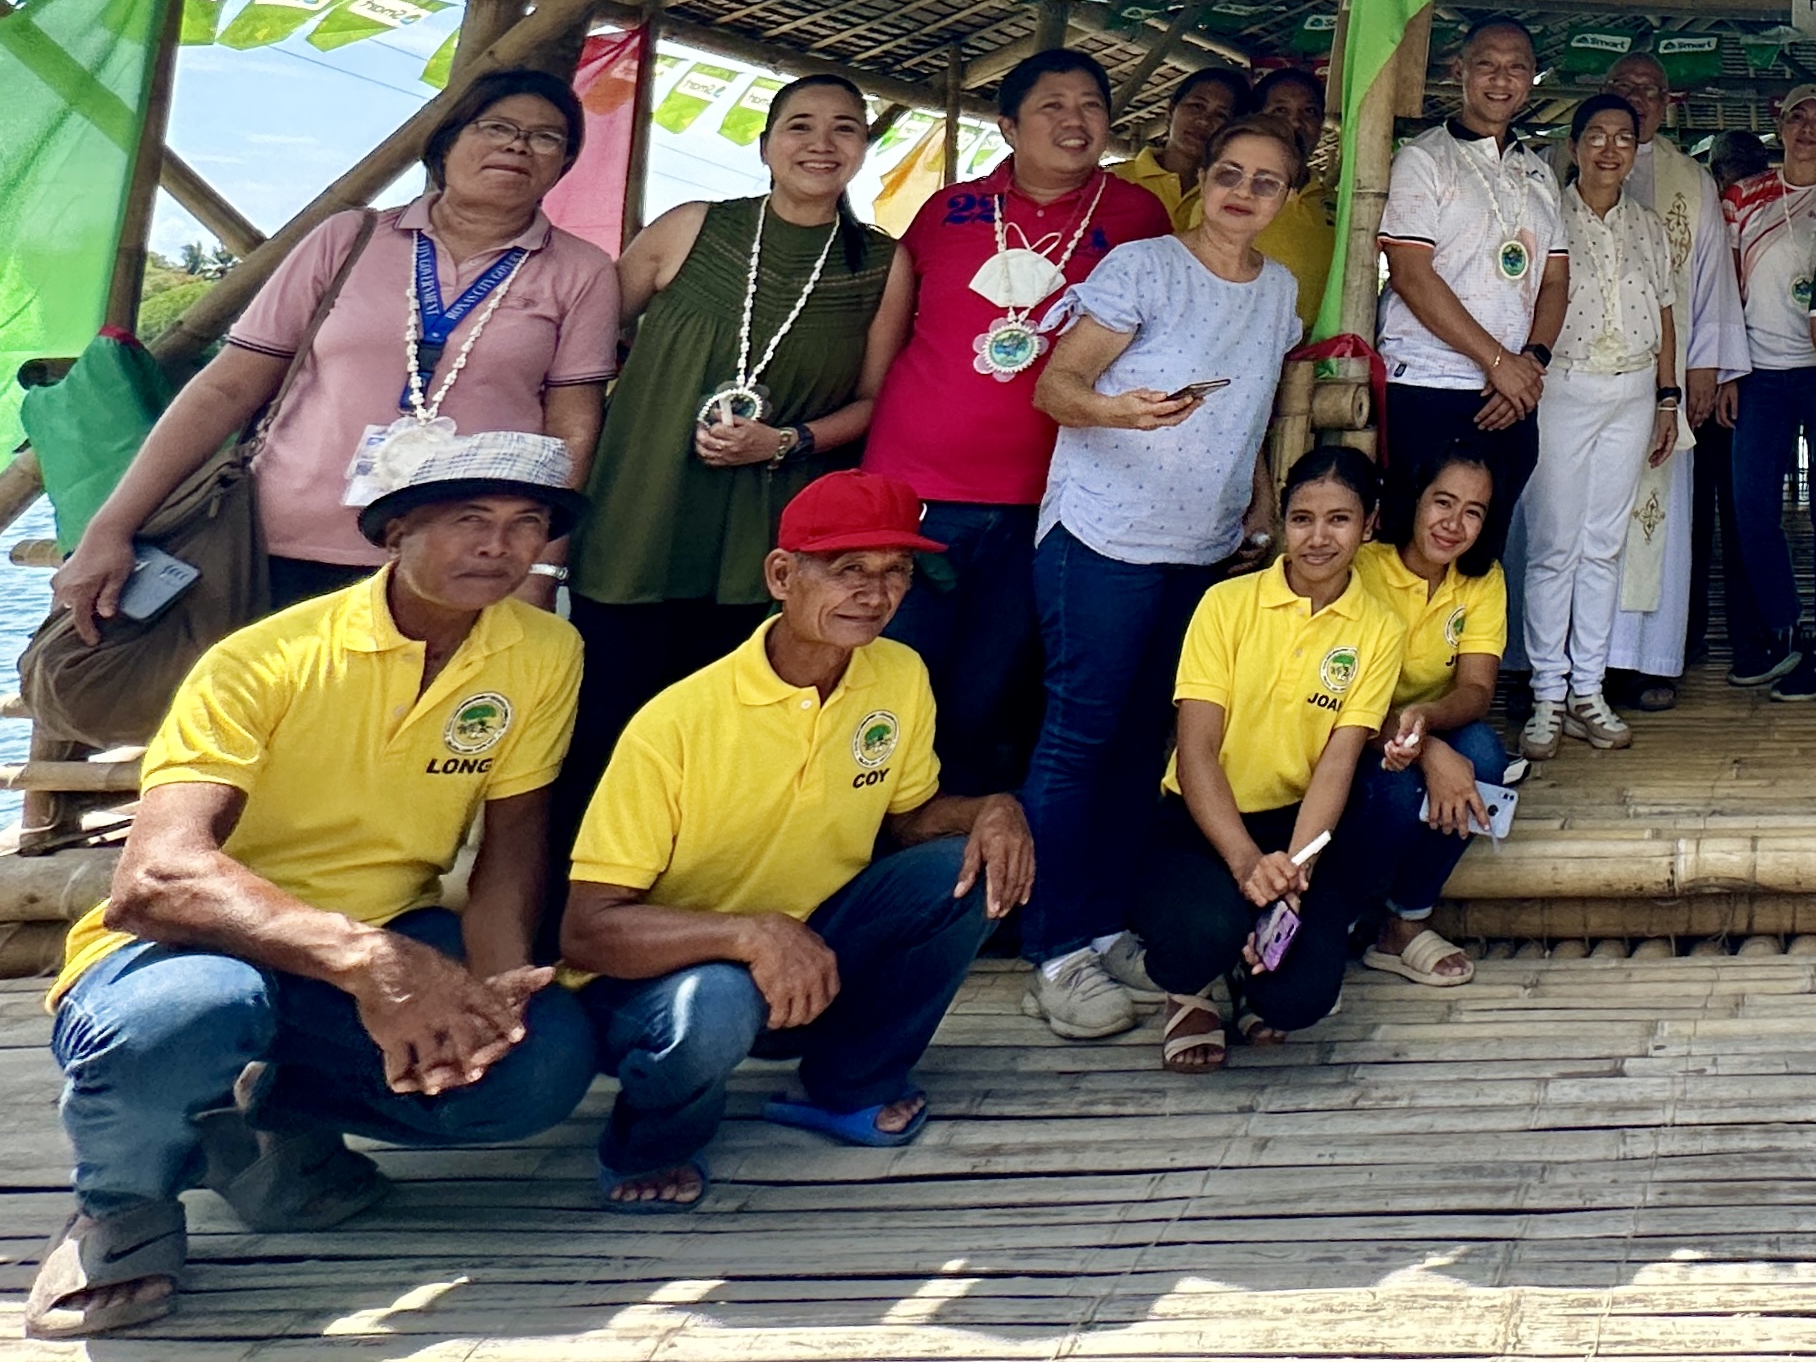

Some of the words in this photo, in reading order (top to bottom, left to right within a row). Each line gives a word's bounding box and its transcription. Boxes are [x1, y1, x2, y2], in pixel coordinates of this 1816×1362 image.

[942, 193, 1005, 227] 22
[419, 259, 440, 316] GOVERNMENT
[472, 277, 497, 297] CITY
[426, 758, 494, 774] LONG
[852, 768, 890, 789] COY
